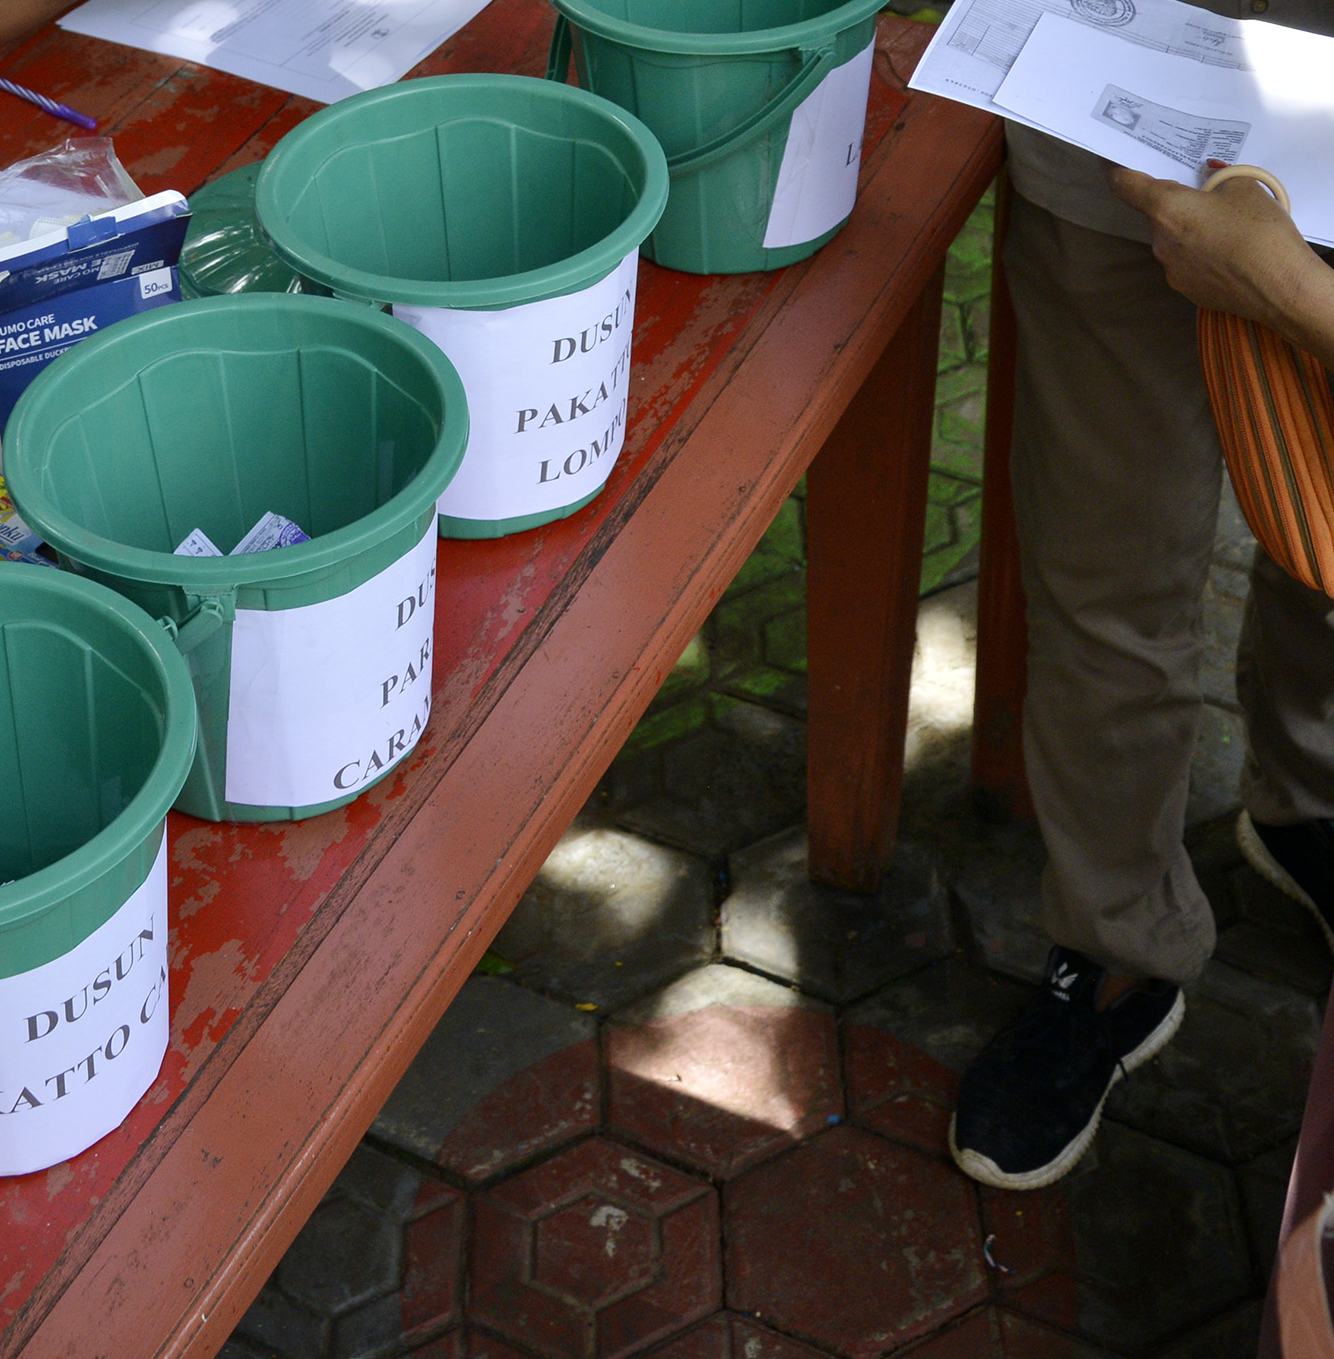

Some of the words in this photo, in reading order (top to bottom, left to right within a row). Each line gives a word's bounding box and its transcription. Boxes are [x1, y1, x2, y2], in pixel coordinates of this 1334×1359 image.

[27, 313, 56, 329] CARE
[43, 315, 98, 343] MASK
[23, 912, 155, 1044] DUSUN
